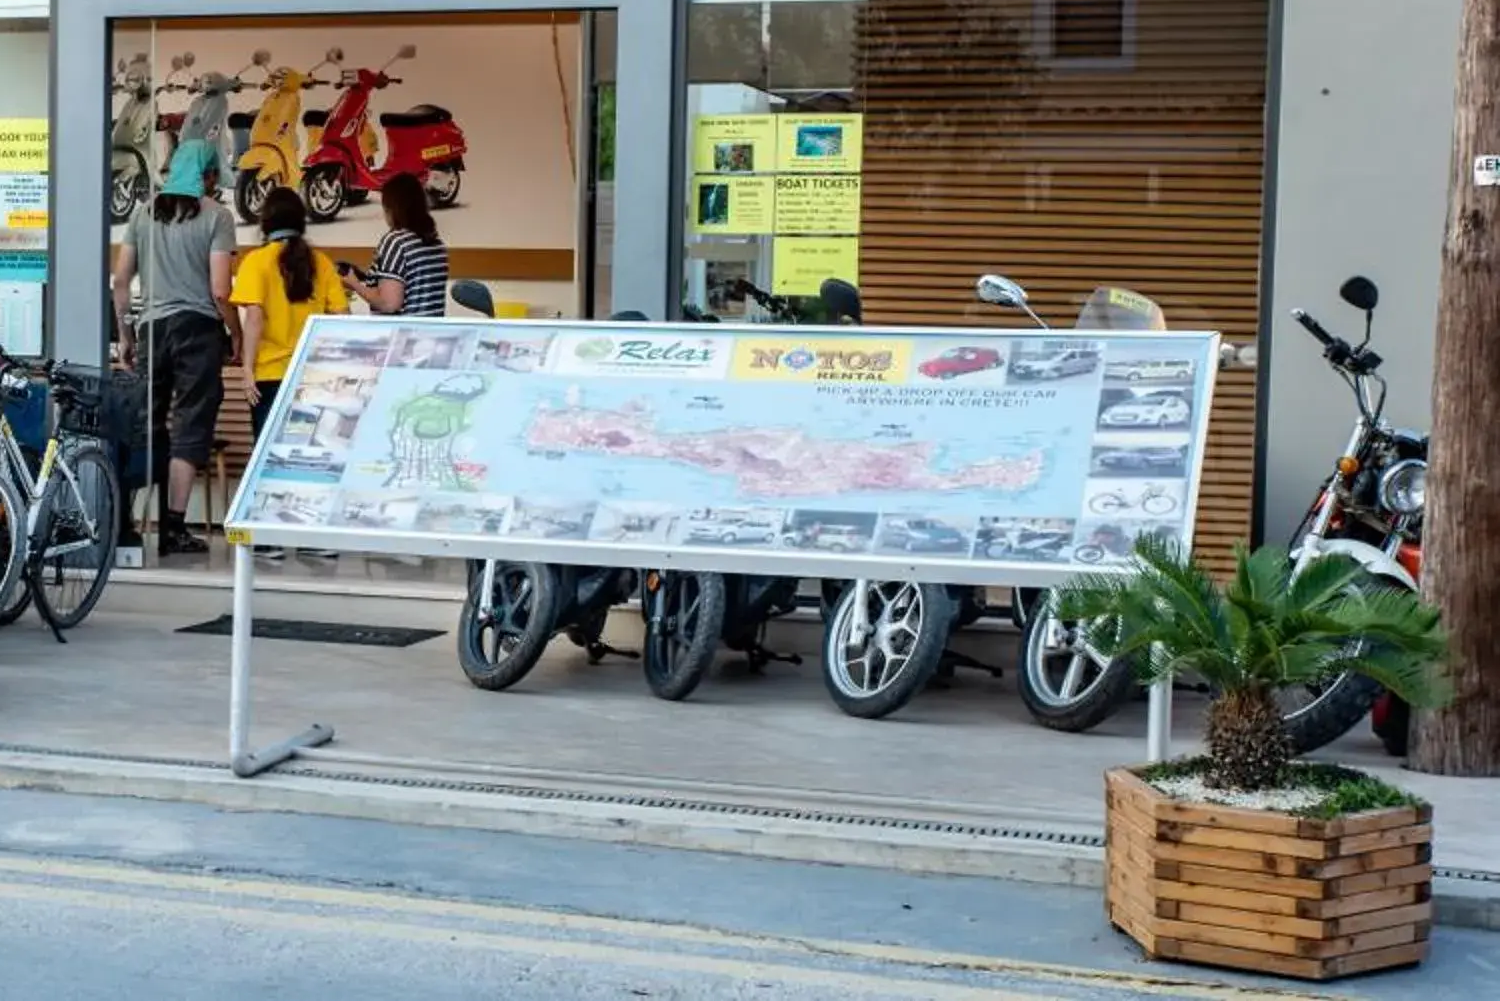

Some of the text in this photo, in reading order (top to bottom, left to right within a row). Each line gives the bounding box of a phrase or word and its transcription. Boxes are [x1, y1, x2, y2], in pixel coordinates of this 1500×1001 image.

[777, 178, 808, 189] BOAT
[813, 178, 859, 189] TICKETS
[616, 339, 714, 362] Relax
[816, 372, 886, 382] RENTAL
[899, 387, 943, 397] DROP
[946, 388, 978, 398] OFF
[983, 389, 1018, 399] OUR
[1022, 389, 1057, 399] CAR
